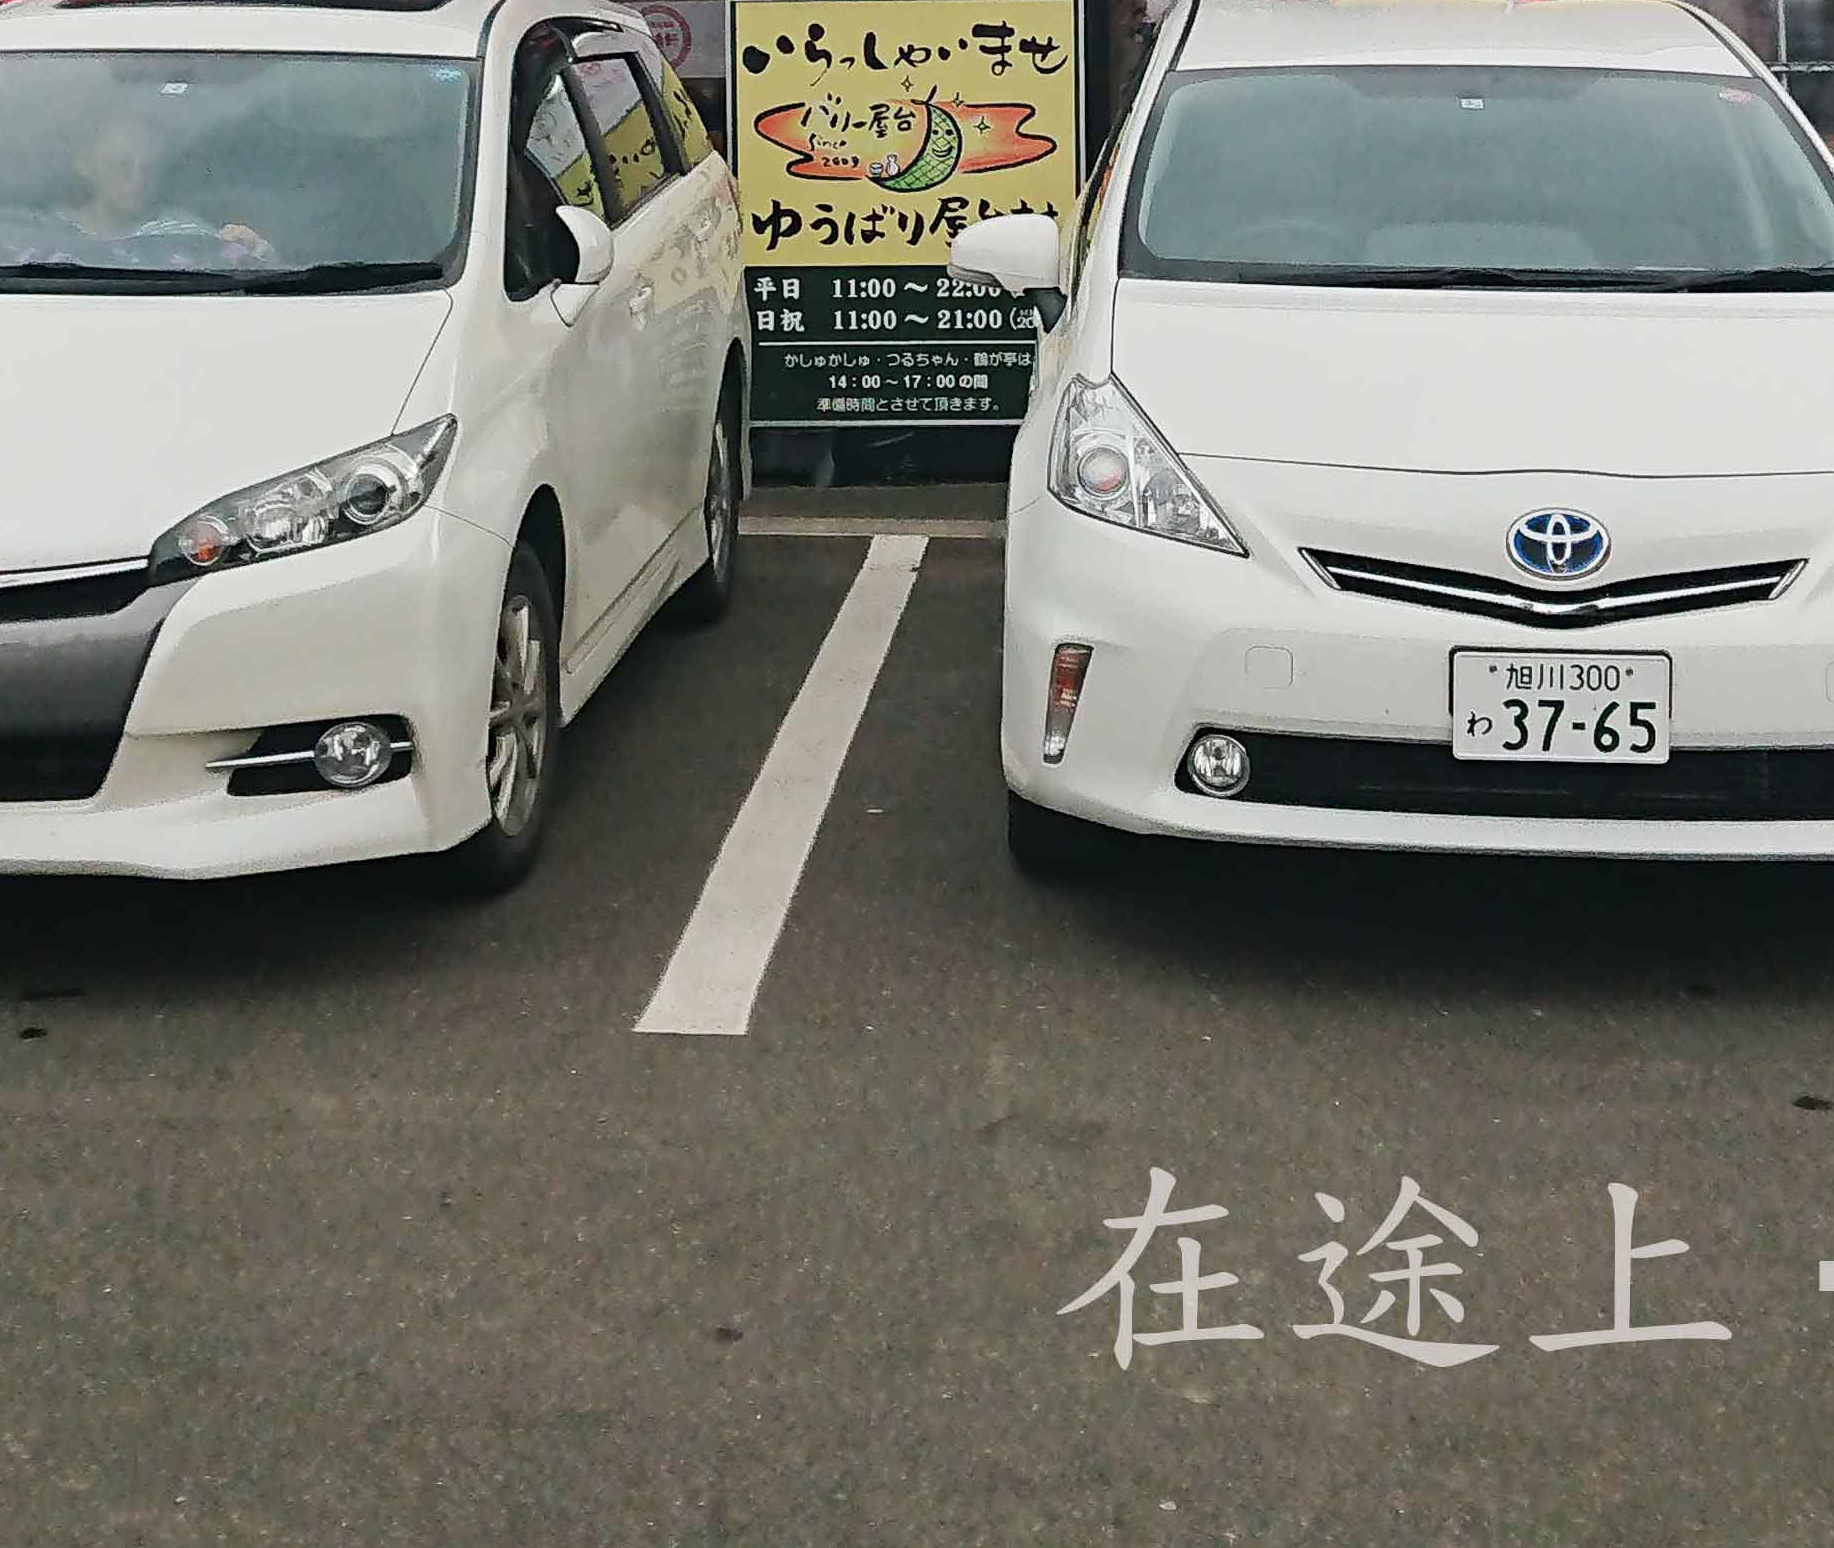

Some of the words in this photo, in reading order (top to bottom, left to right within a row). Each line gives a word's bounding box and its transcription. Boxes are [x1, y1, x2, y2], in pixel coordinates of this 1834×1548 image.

[742, 21, 1069, 87] いらっしゃいませ
[800, 93, 915, 138] バリー屋台
[751, 196, 1059, 251] ゆうばり屋
[753, 276, 801, 301] 平日
[831, 279, 896, 299] 11:00
[757, 308, 806, 333] 日祝
[832, 310, 897, 331] 11:00
[937, 309, 1002, 330] 21:00
[1467, 710, 1493, 737] わ
[1502, 699, 1657, 753] 37-65
